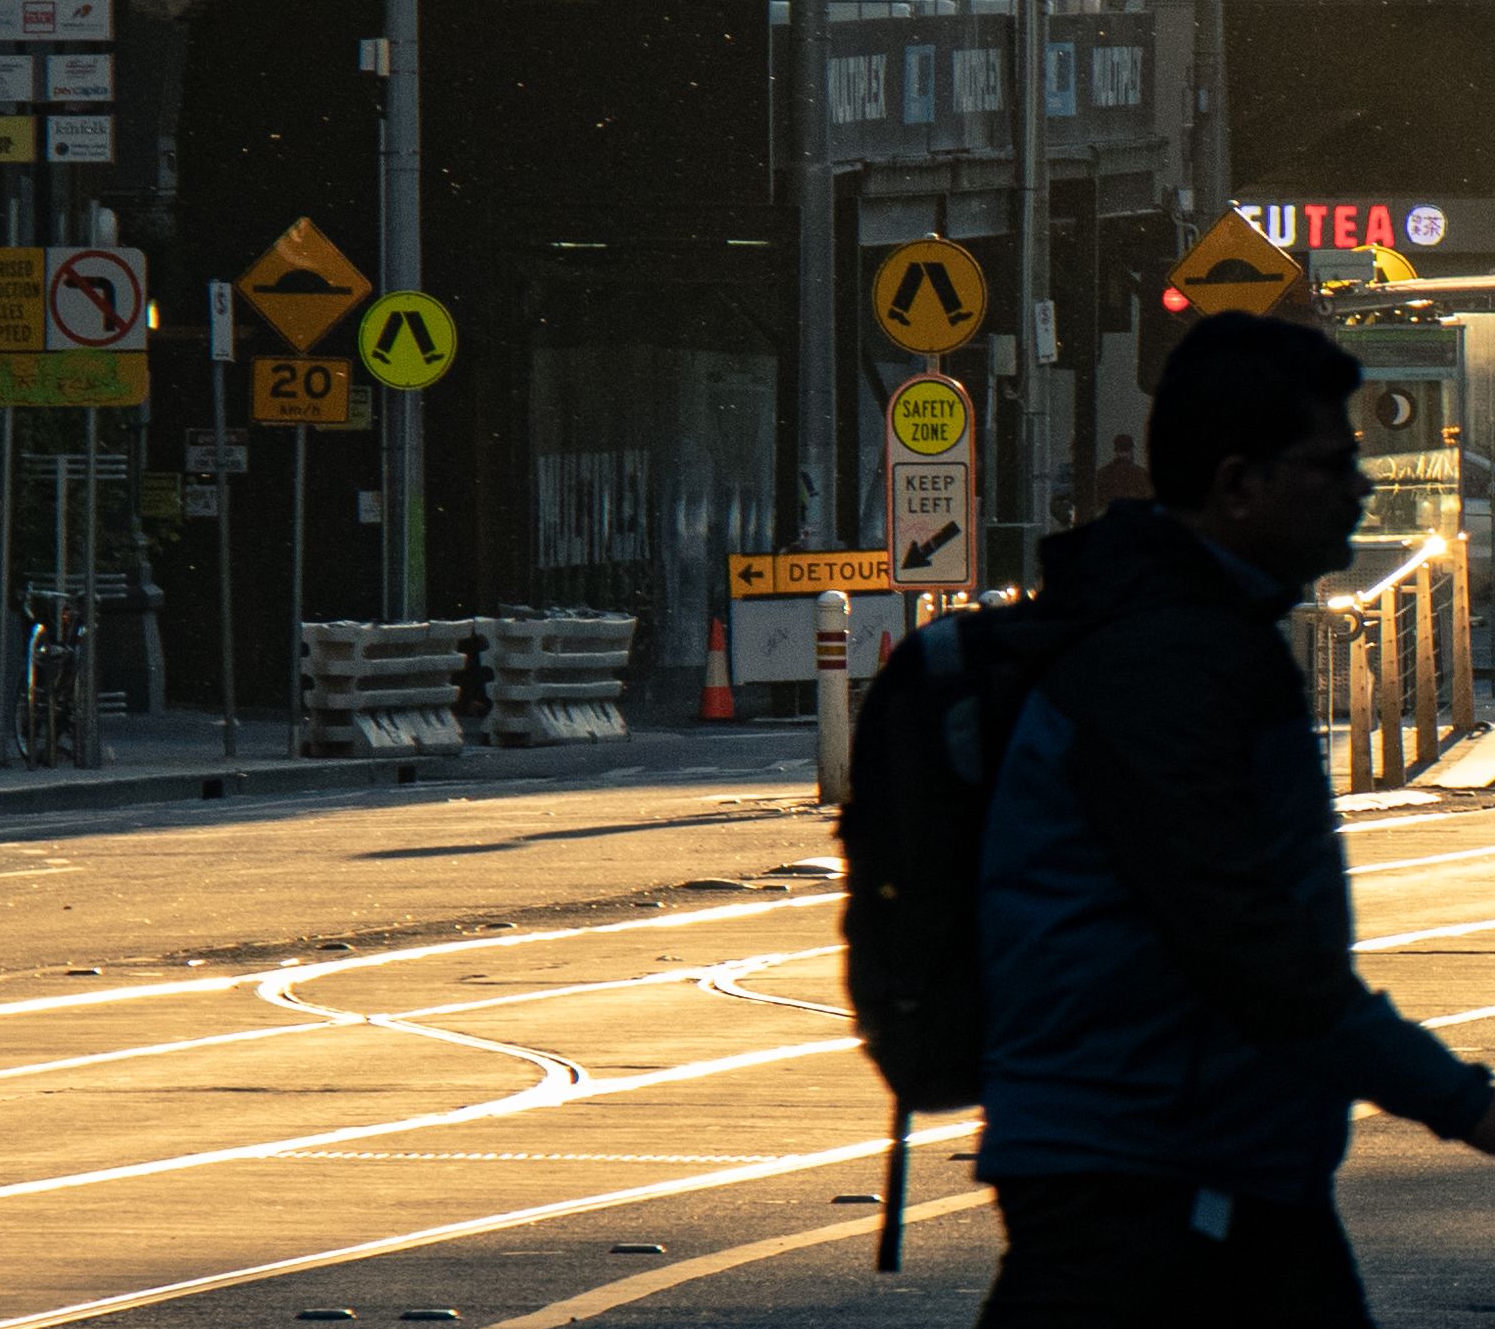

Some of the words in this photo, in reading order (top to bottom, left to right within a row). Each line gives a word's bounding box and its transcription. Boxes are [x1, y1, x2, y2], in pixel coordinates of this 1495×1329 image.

[1303, 203, 1396, 249] TEA
[269, 364, 332, 399] 20
[279, 404, 322, 416] km/h
[902, 399, 955, 418] SAFETY
[911, 423, 948, 441] ZONE
[906, 475, 954, 491] KEEP
[908, 497, 952, 513] LEFT
[789, 561, 889, 582] DETOUR
